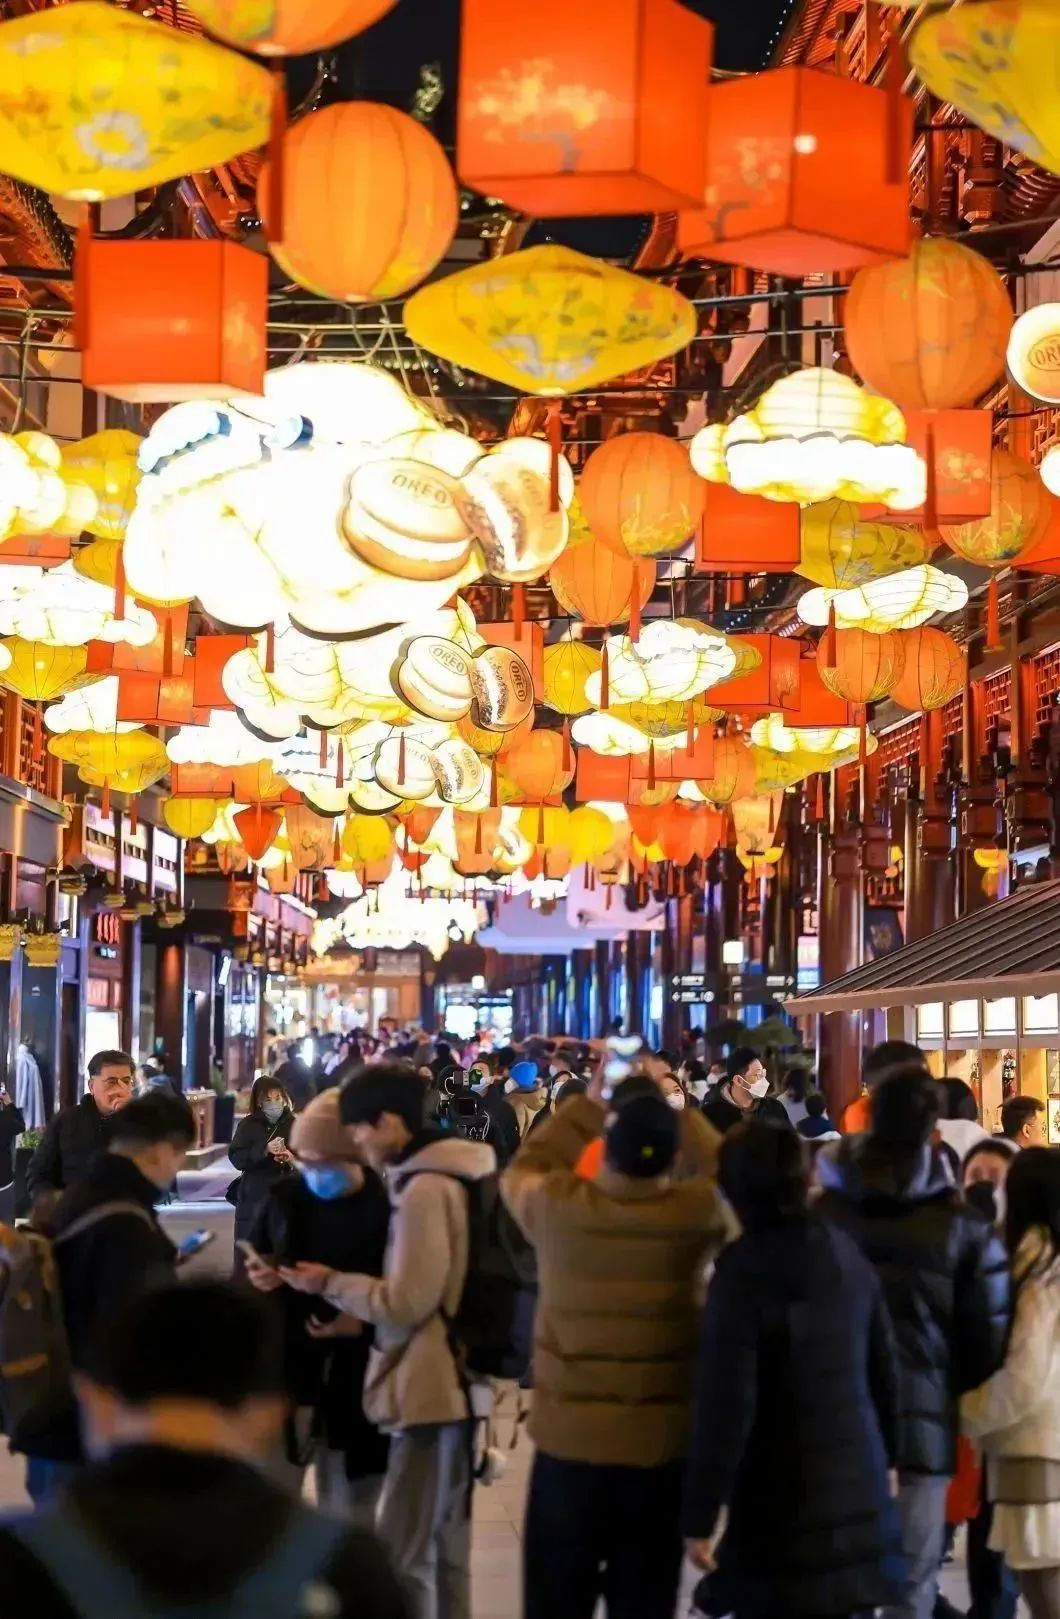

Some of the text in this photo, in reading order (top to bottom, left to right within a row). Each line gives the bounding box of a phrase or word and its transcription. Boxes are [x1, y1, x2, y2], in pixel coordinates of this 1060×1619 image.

[1034, 343, 1060, 366] OR
[392, 473, 448, 505] OREO
[432, 647, 465, 673] OREO
[511, 664, 526, 700] OREO
